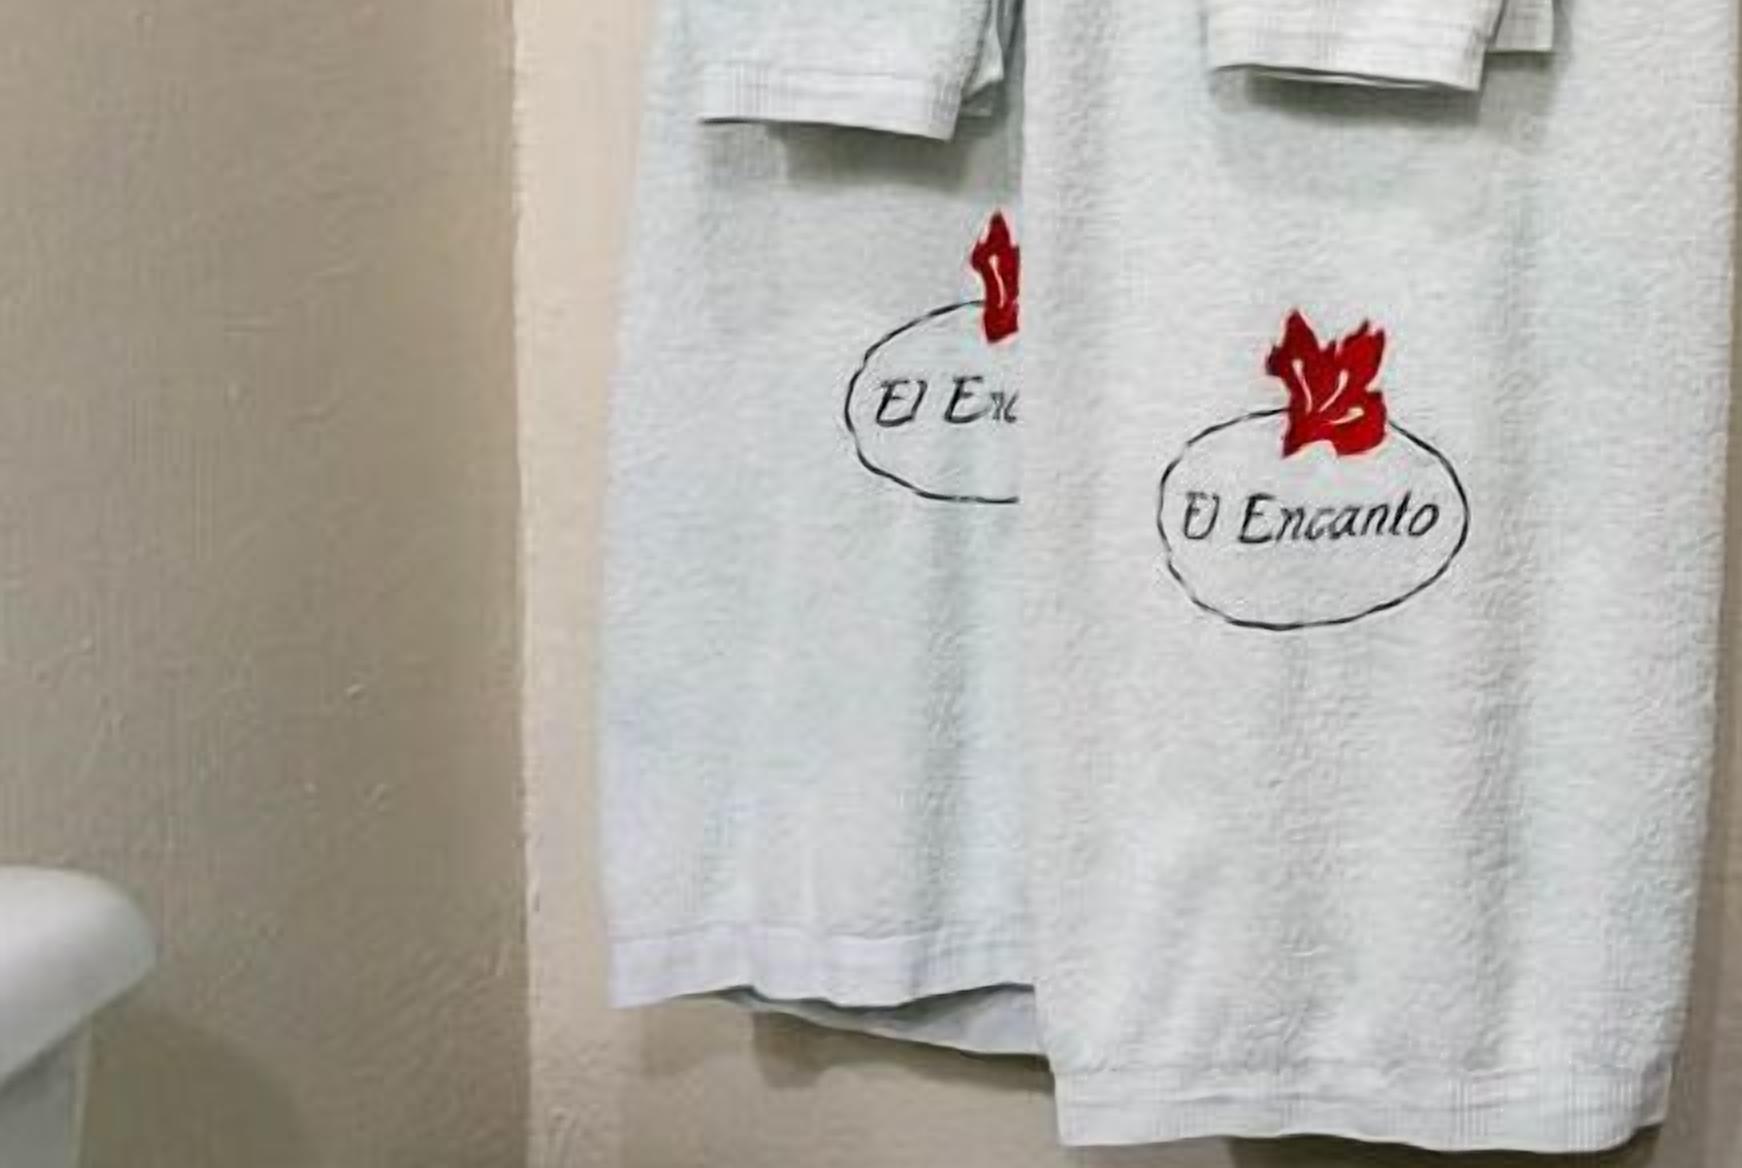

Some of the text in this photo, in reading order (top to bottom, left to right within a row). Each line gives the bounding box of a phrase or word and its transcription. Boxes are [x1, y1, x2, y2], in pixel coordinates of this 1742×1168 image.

[875, 379, 928, 427] El
[1184, 490, 1440, 544] El Encanto
